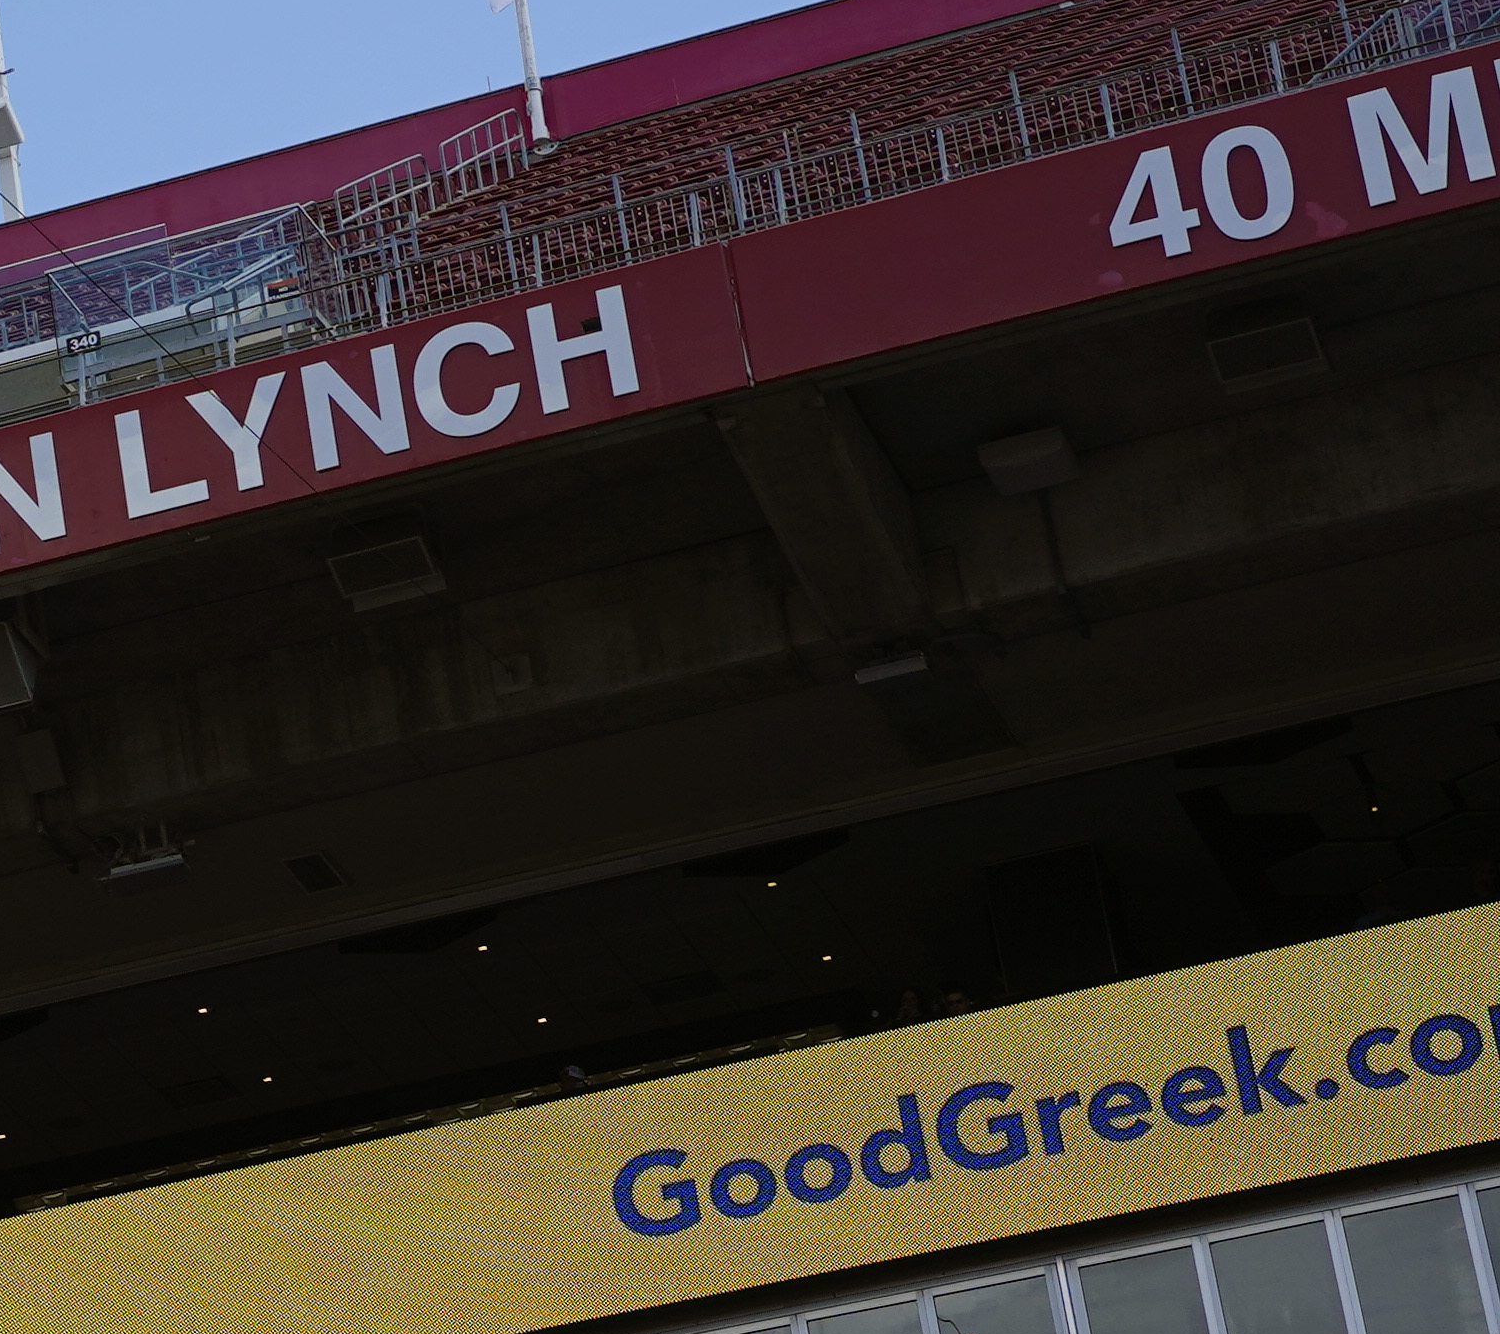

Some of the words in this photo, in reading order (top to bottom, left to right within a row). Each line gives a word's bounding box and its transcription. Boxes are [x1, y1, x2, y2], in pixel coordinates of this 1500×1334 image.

[1108, 125, 1294, 257] 40
[1347, 59, 1500, 207] M
[69, 334, 98, 351] 340
[114, 285, 640, 520] LYNCH
[612, 1003, 1500, 1237] GoodGreek.co
